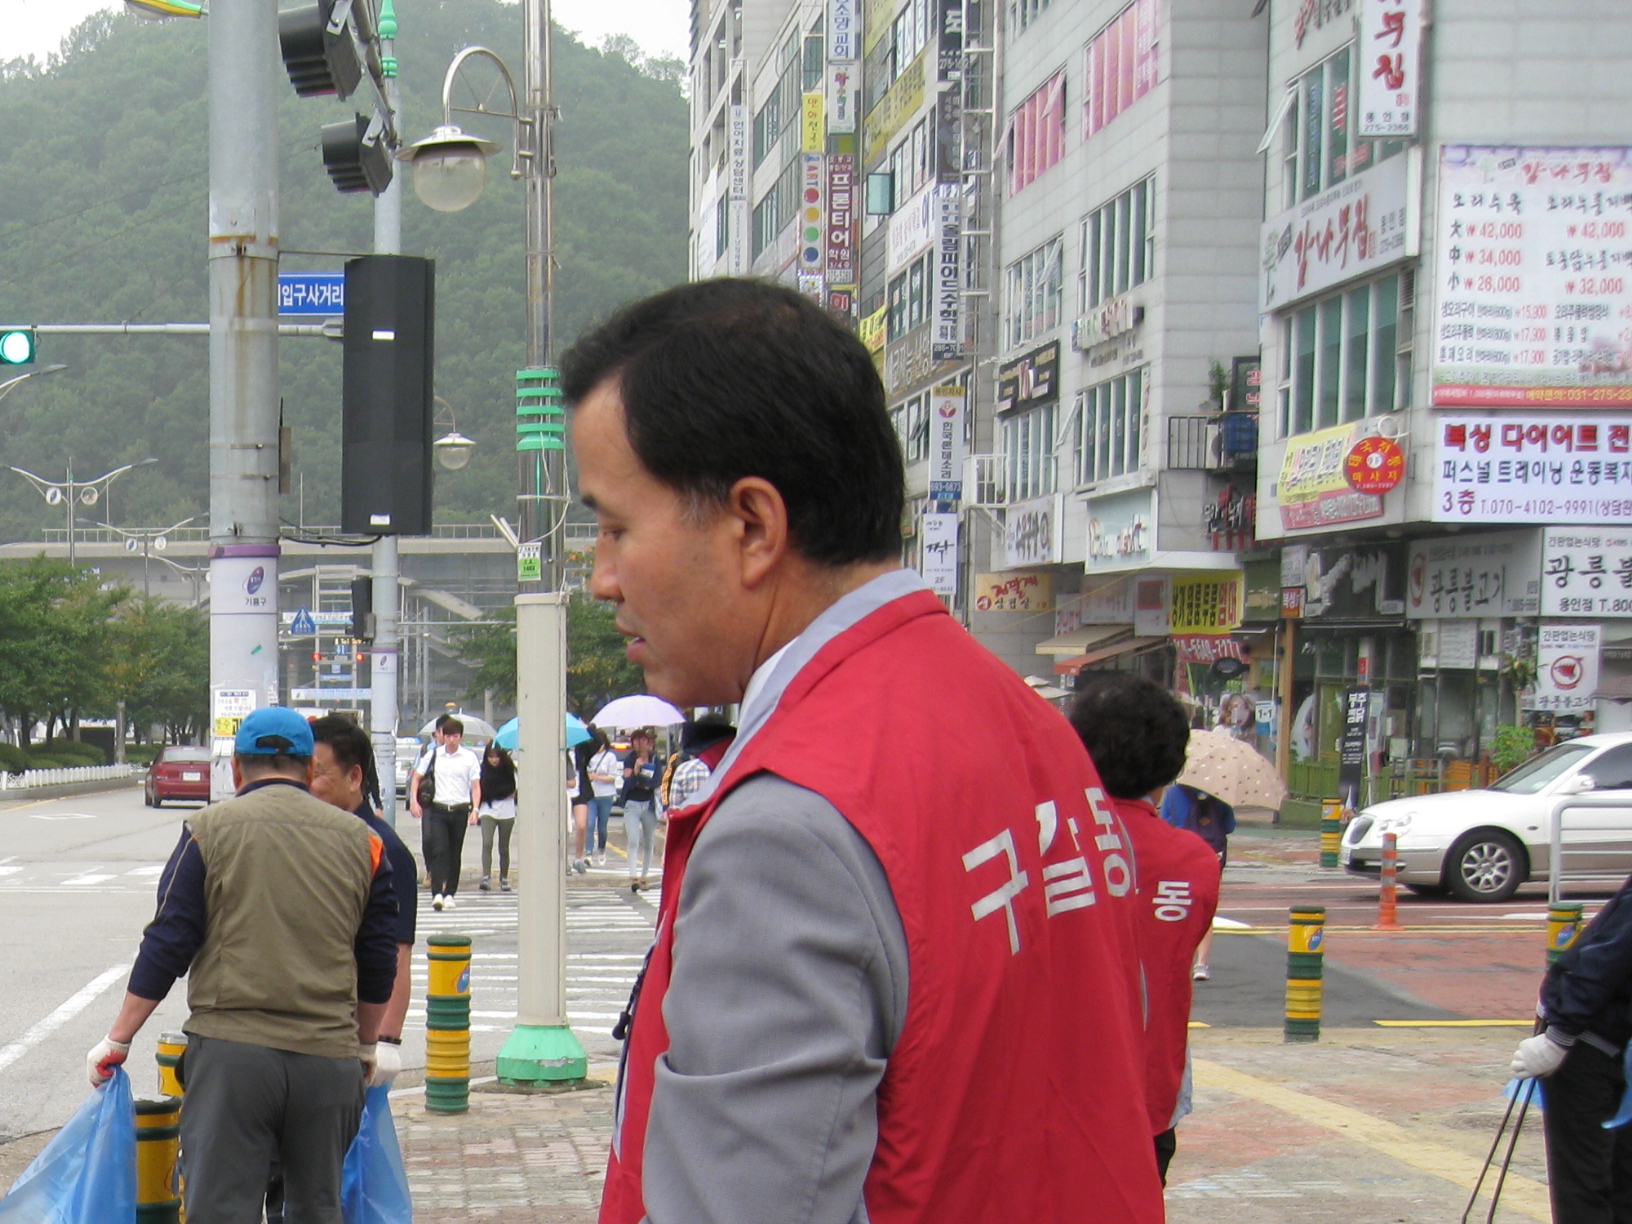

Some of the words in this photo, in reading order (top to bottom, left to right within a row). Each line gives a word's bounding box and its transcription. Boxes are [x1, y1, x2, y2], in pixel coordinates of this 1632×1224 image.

[1371, 0, 1406, 91] 무집
[1478, 248, 1521, 267] 34,000
[1477, 275, 1520, 294] 26,000
[278, 284, 344, 306] 입구사거리
[1500, 424, 1599, 453] 다이어트
[1352, 470, 1398, 483] 마사지
[1442, 459, 1491, 484] 퍼스널
[1496, 459, 1563, 485] 트레이닝
[1547, 536, 1601, 548] 간판없는식당
[1430, 564, 1505, 613] 광릉불고기
[244, 596, 267, 606] 기흥구
[1559, 598, 1593, 613] 용인점
[1257, 708, 1273, 719] 1+1
[1152, 880, 1203, 923] 동
